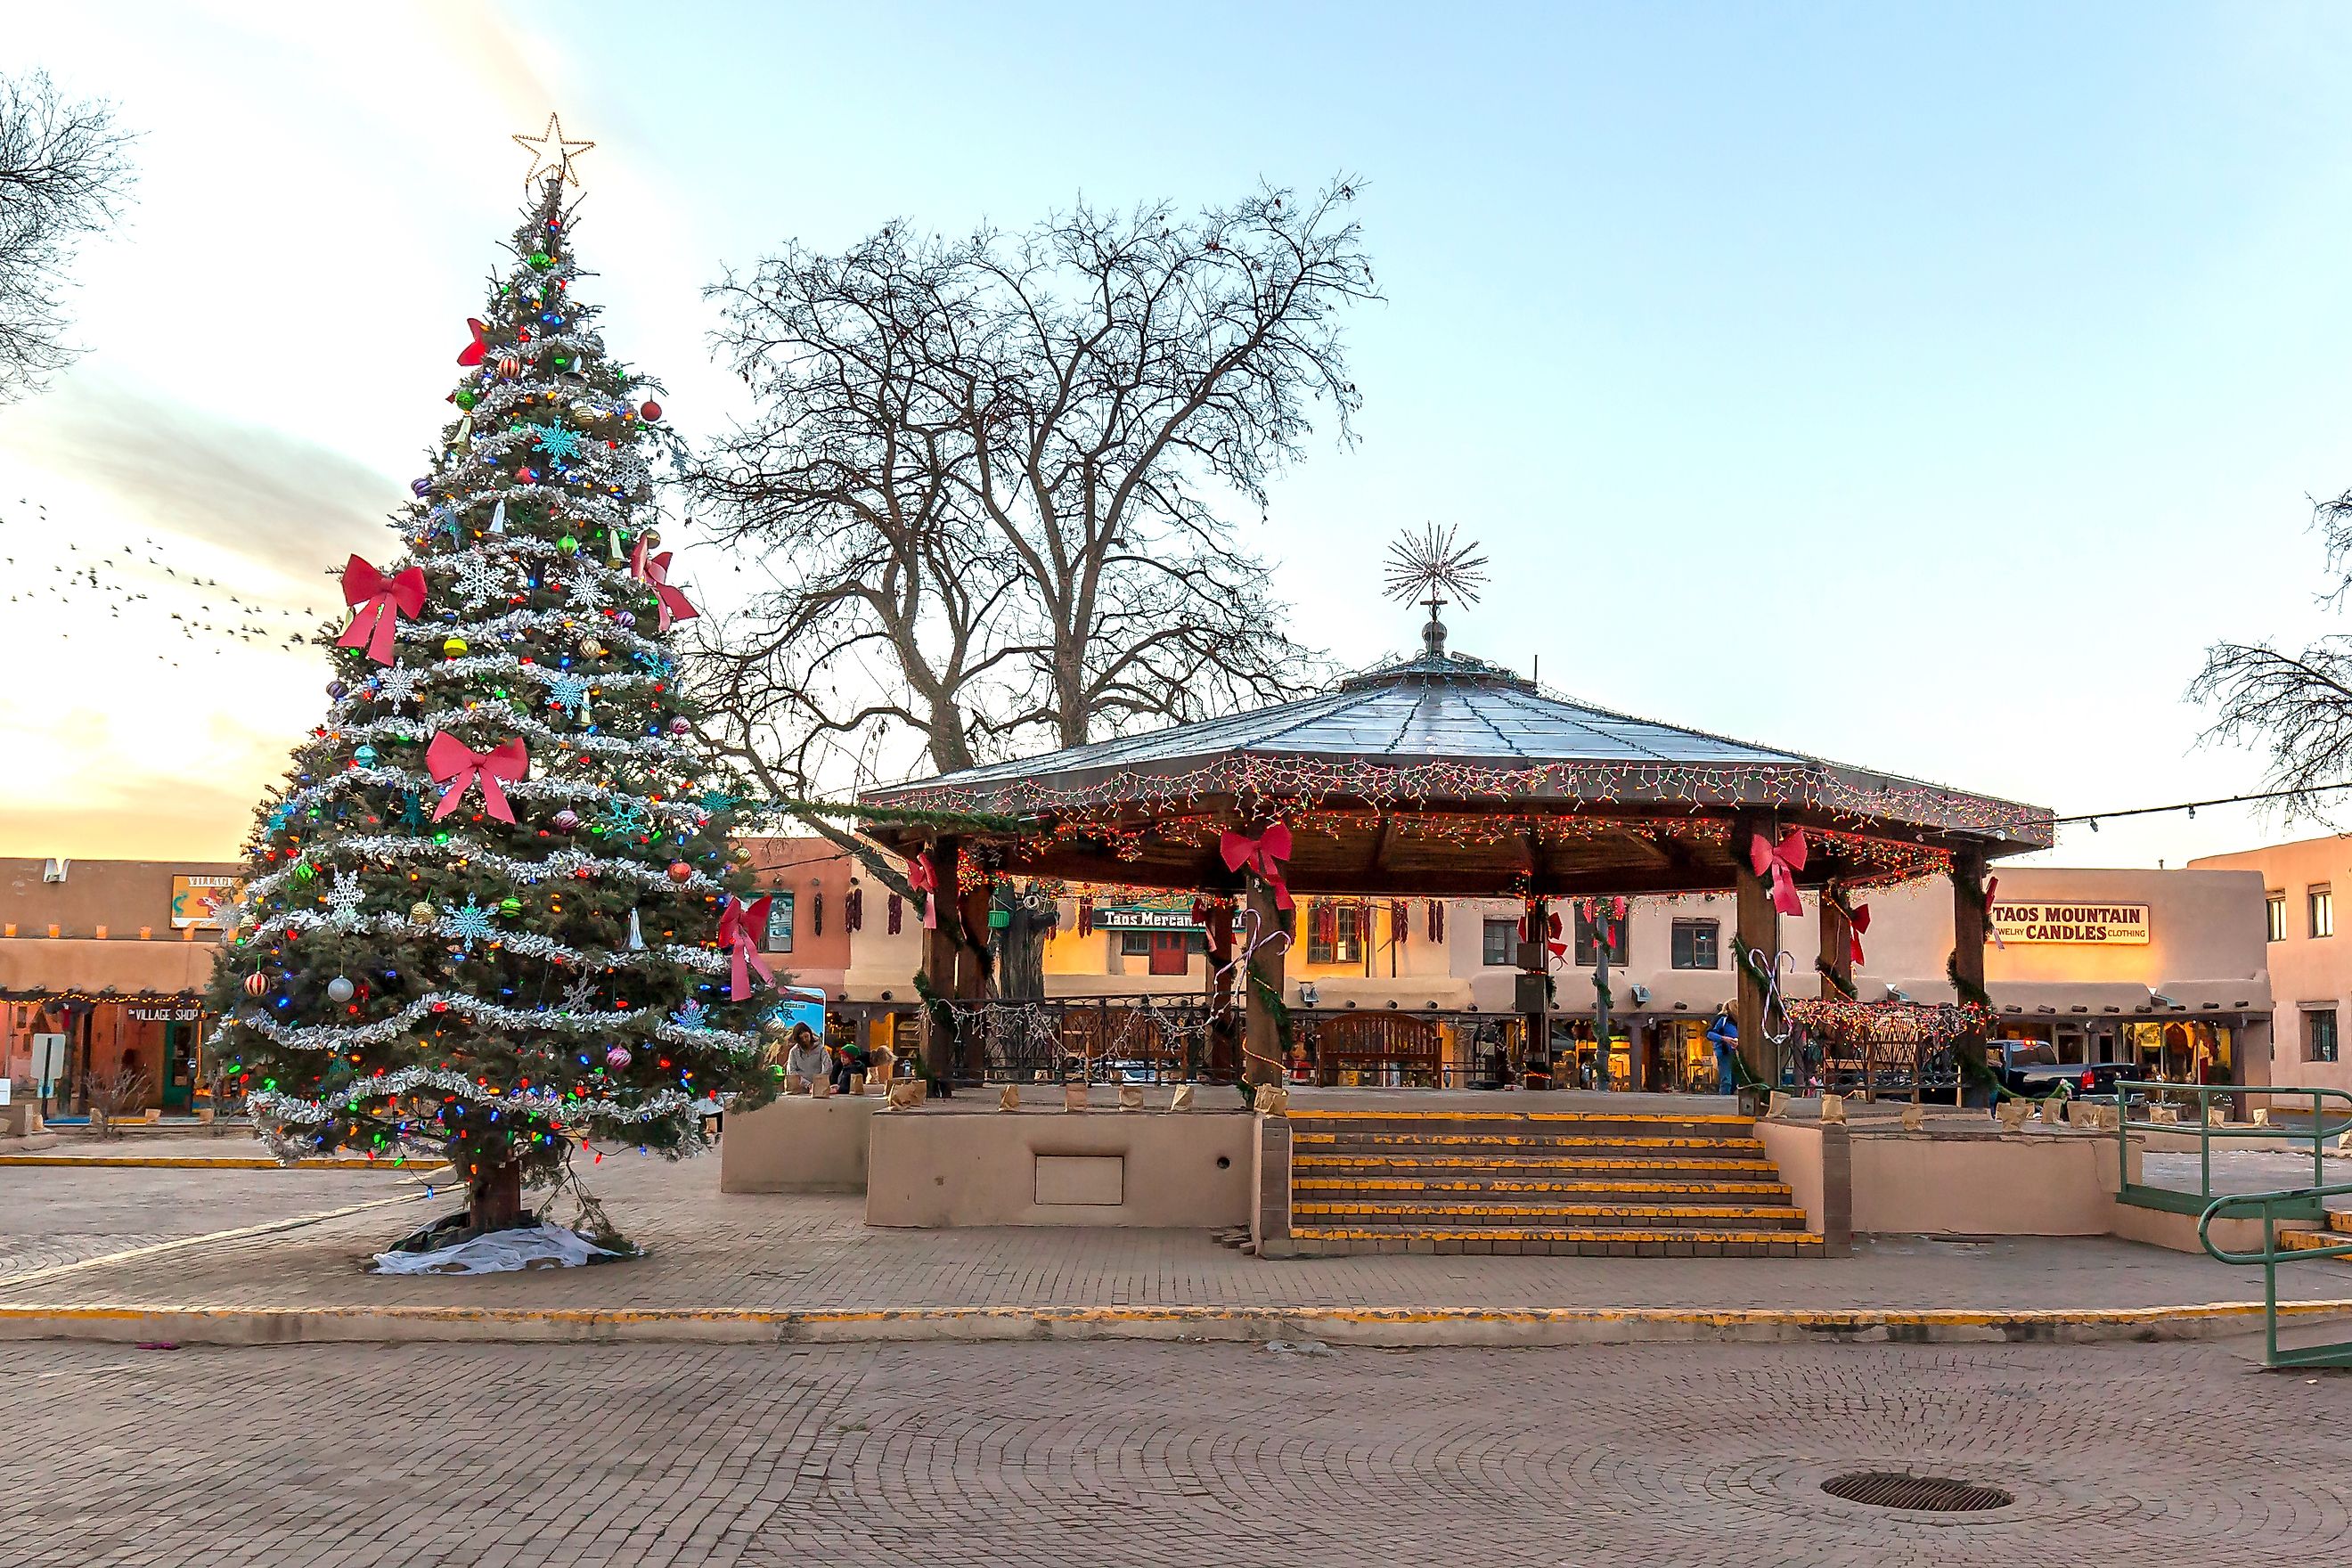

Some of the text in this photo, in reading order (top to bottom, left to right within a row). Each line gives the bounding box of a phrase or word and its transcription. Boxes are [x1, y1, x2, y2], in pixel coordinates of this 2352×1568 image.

[1105, 911, 1206, 928] Taos Mercan
[1993, 906, 2141, 924] TAOS MOUNTAIN
[2025, 924, 2107, 941] CANDLES
[2107, 929, 2145, 938] CLOTHING
[135, 1009, 171, 1021] VILLAGE
[175, 1009, 199, 1021] SHOP
